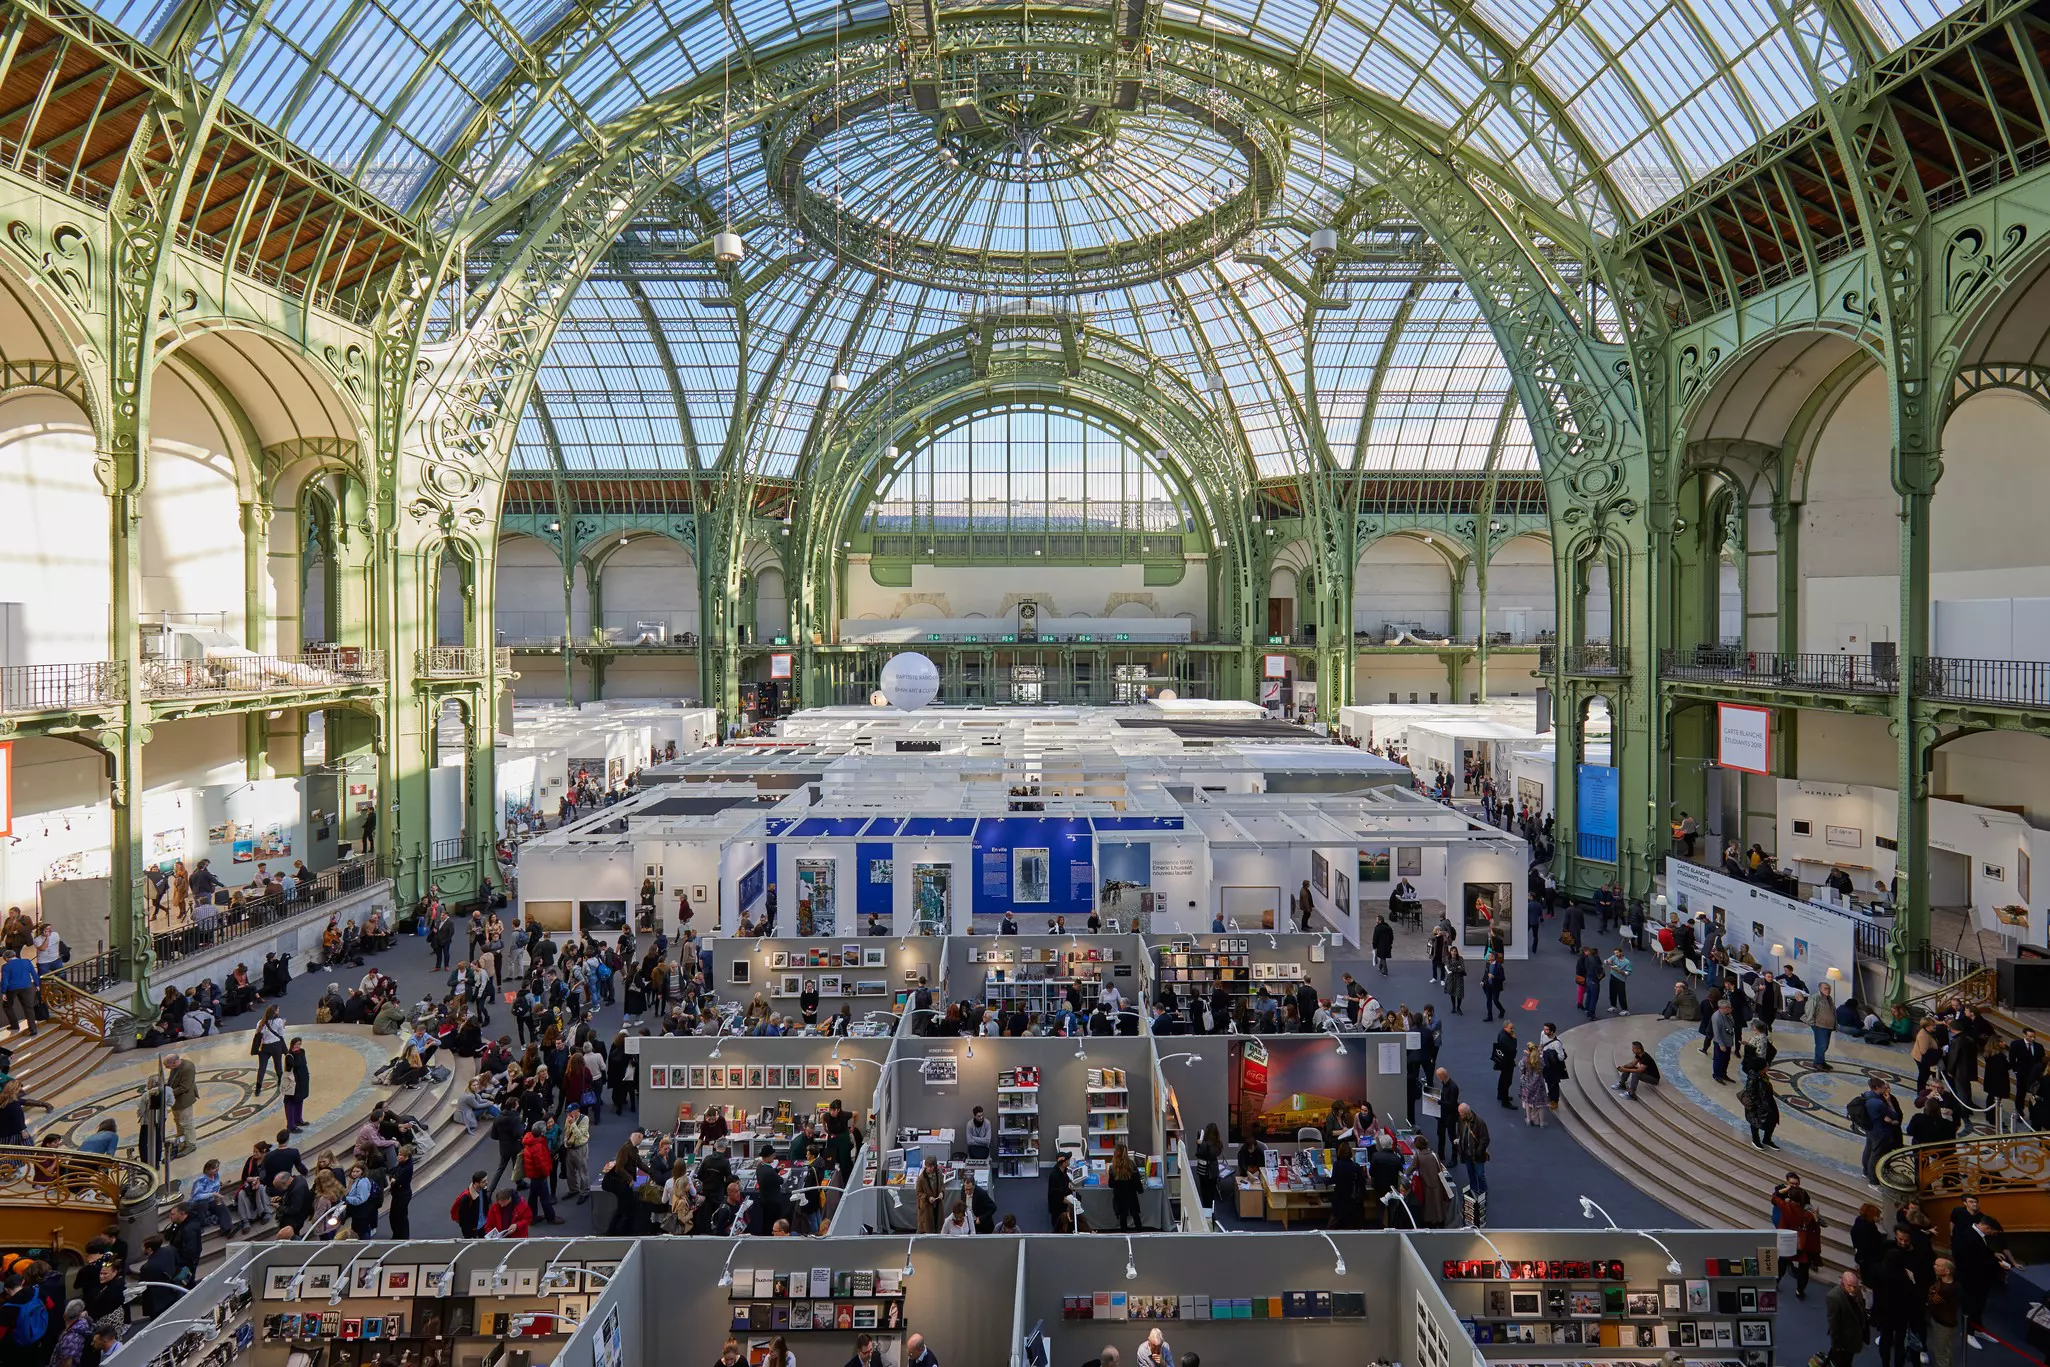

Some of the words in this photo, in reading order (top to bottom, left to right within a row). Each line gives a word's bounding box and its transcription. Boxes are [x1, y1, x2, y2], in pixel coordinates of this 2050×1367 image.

[1740, 730, 1763, 740] BLANCHE
[1939, 841, 1956, 849] OFFICE
[1677, 863, 1690, 871] CARTE
[1690, 868, 1710, 878] BLANCHE
